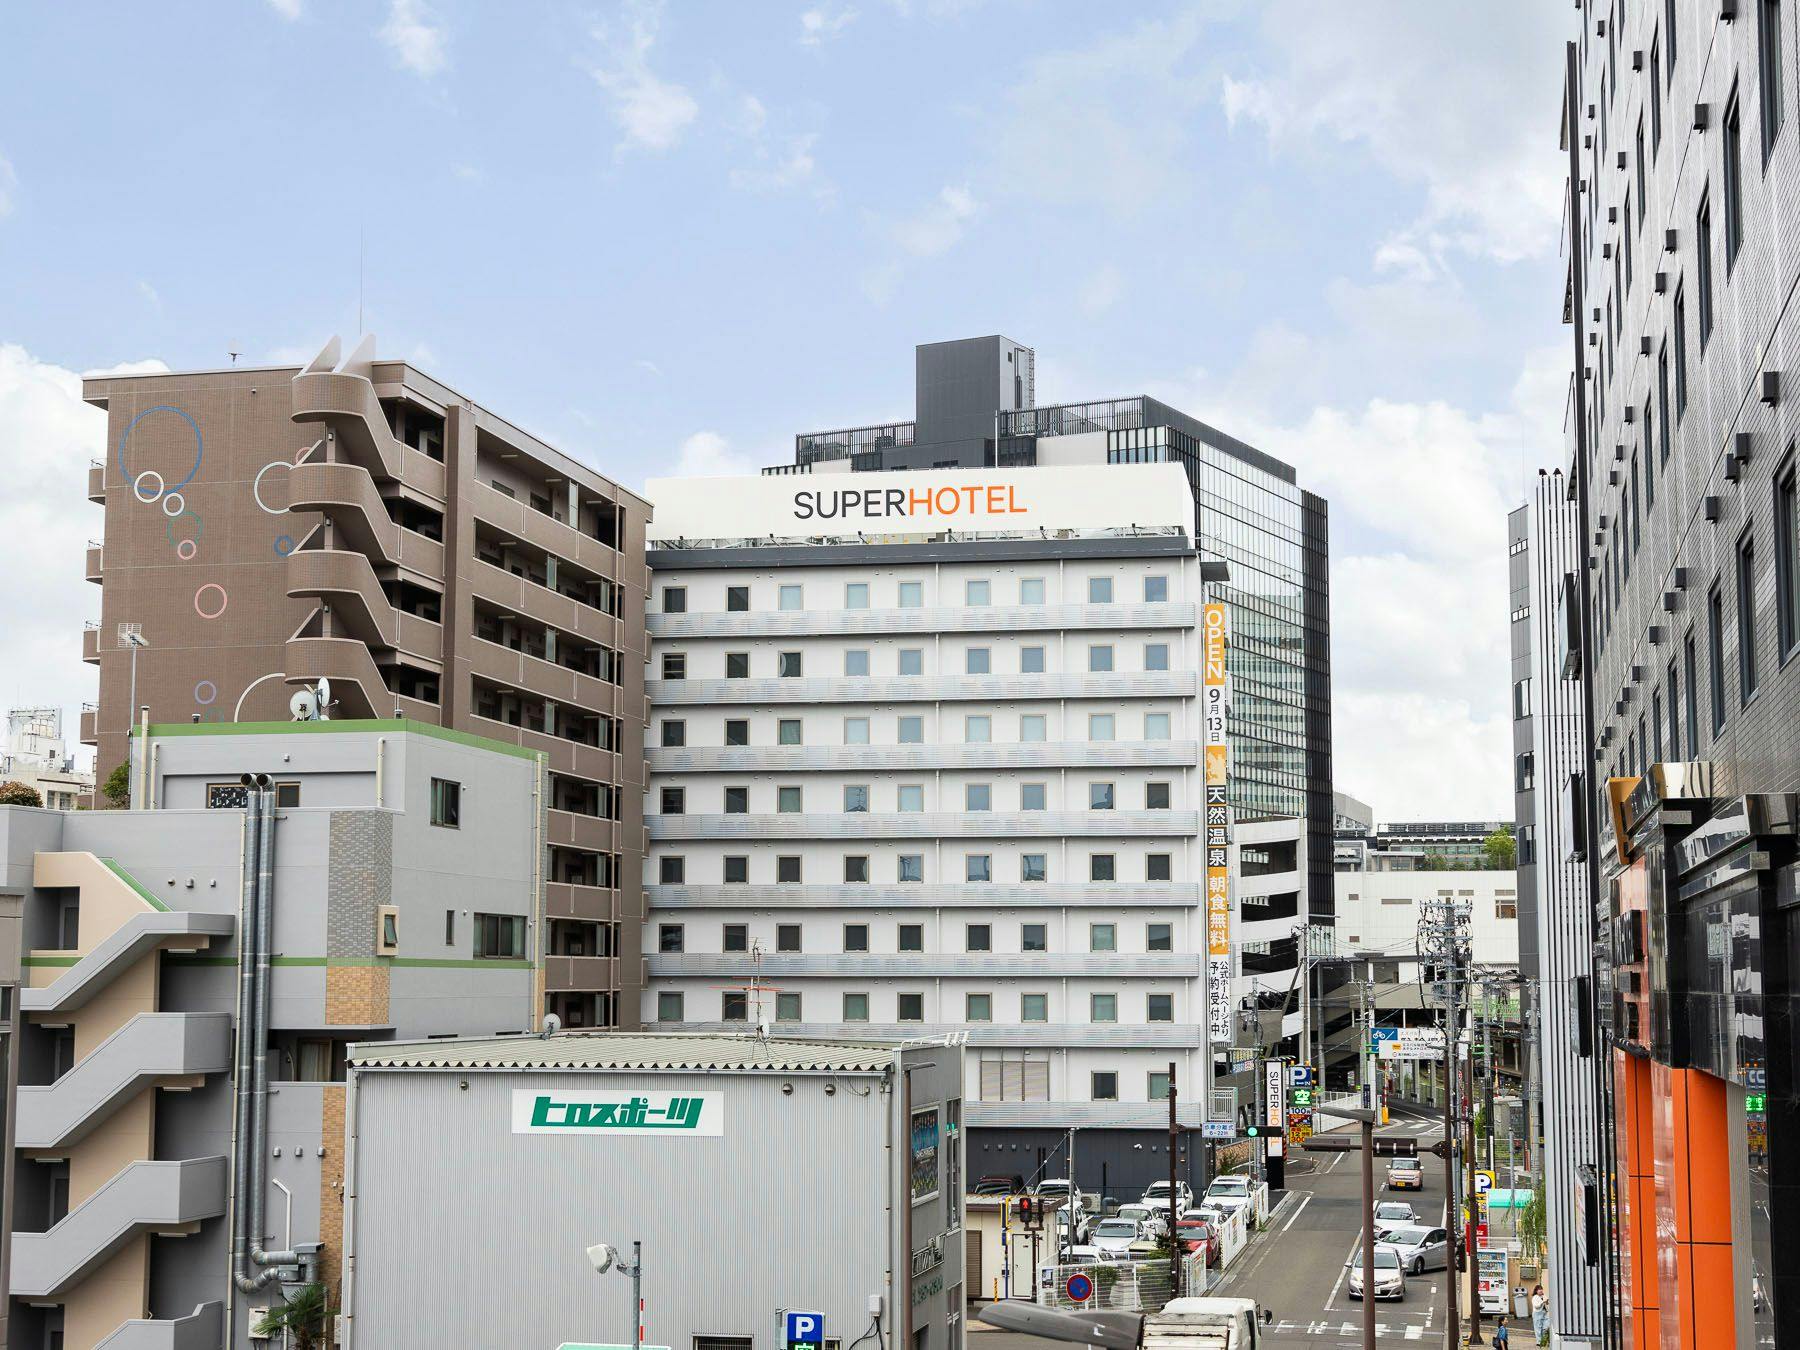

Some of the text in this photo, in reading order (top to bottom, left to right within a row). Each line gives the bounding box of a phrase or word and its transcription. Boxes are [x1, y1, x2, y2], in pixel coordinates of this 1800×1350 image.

[794, 486, 1027, 519] SUPERHOTEL
[1205, 609, 1223, 679] OPEN
[1208, 786, 1227, 867] 天然温泉
[1209, 876, 1228, 947] 朝食無料
[1210, 961, 1220, 1036] 予約受付中
[1269, 1071, 1280, 1147] SUPERHOEL
[1290, 1067, 1307, 1086] P
[531, 1096, 705, 1128] ヒロスポーツ
[796, 1316, 815, 1339] P
